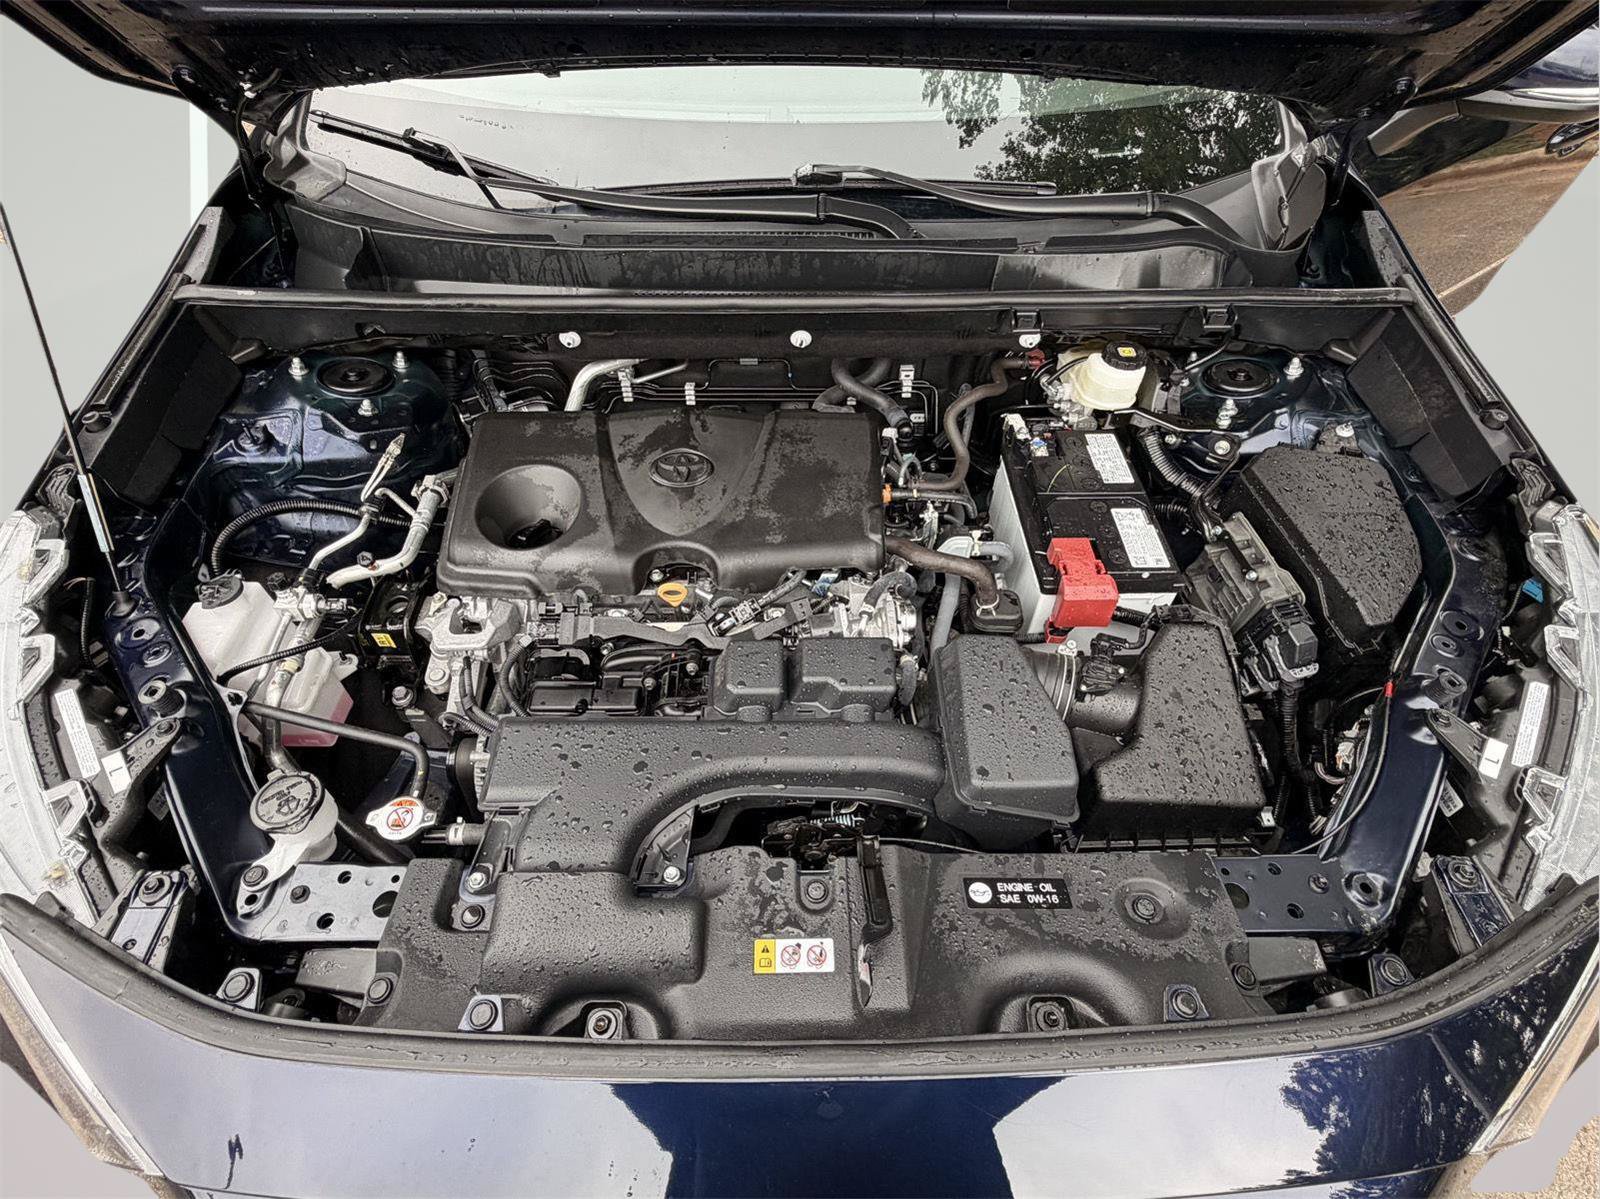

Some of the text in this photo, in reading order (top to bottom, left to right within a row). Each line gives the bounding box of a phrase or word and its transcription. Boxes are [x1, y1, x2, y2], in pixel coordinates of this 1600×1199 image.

[997, 882, 1057, 893] ENGINE OIL
[1000, 894, 1059, 904] SAE 0W-16
